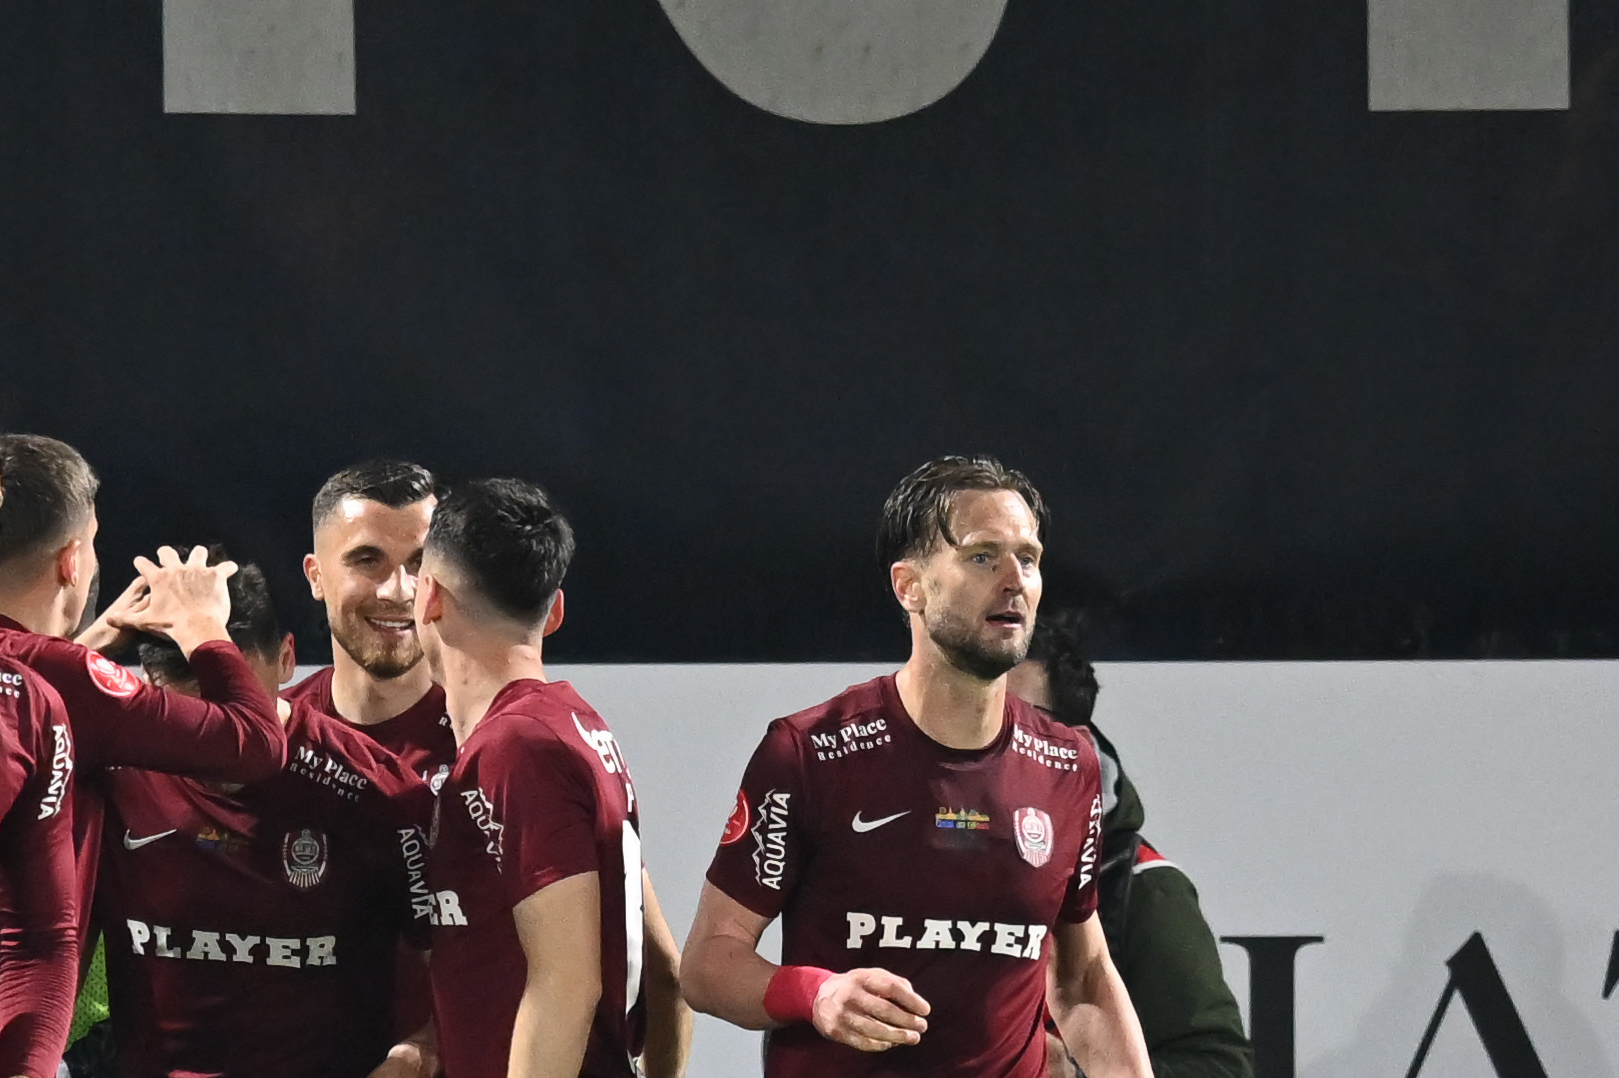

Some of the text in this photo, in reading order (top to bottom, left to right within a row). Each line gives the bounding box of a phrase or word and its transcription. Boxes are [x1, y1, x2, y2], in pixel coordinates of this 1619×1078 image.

[811, 718, 887, 749] My Place
[1033, 738, 1079, 760] Place
[294, 746, 367, 790] My Place
[762, 793, 791, 890] AQUAVIA
[126, 918, 338, 969] PLAYER
[846, 911, 1048, 960] PLAYER
